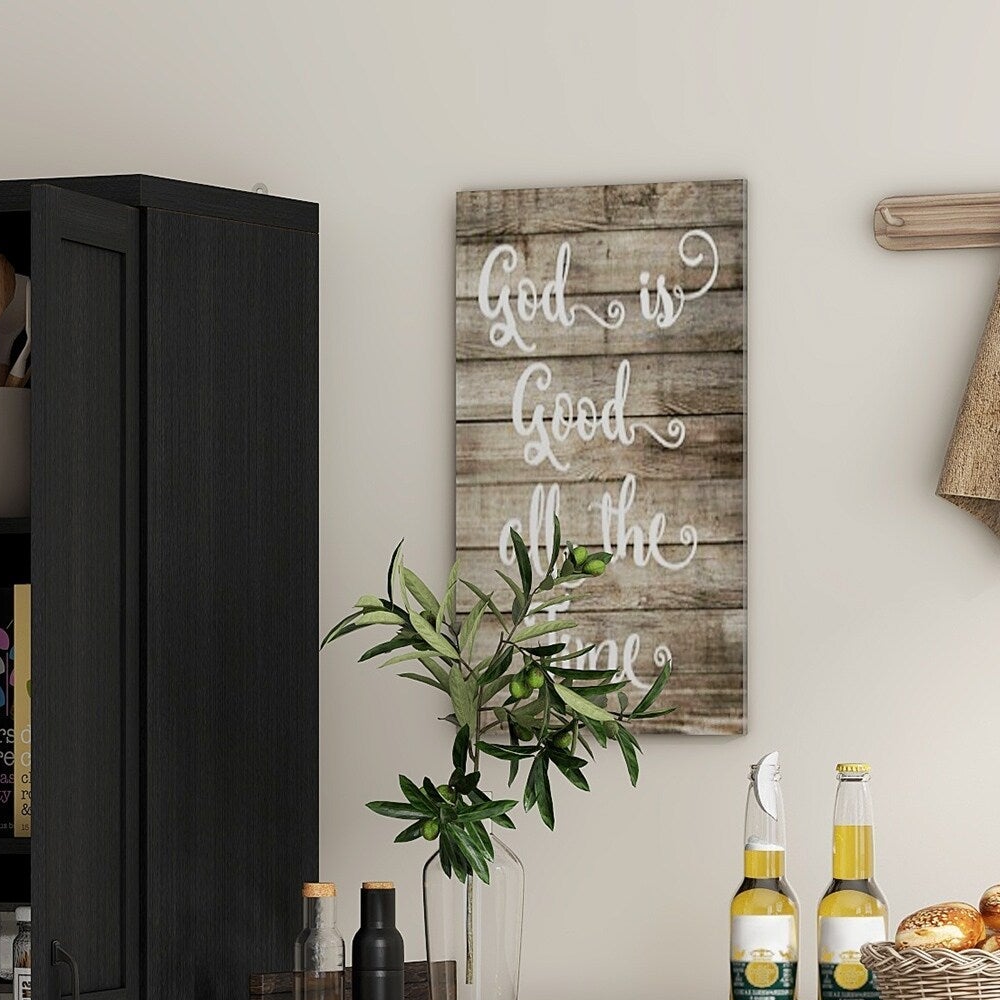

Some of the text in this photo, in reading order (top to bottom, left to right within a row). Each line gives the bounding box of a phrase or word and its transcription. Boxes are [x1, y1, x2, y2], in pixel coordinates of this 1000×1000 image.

[478, 228, 719, 351] God is
[512, 359, 686, 472] Good
[589, 473, 698, 570] the
